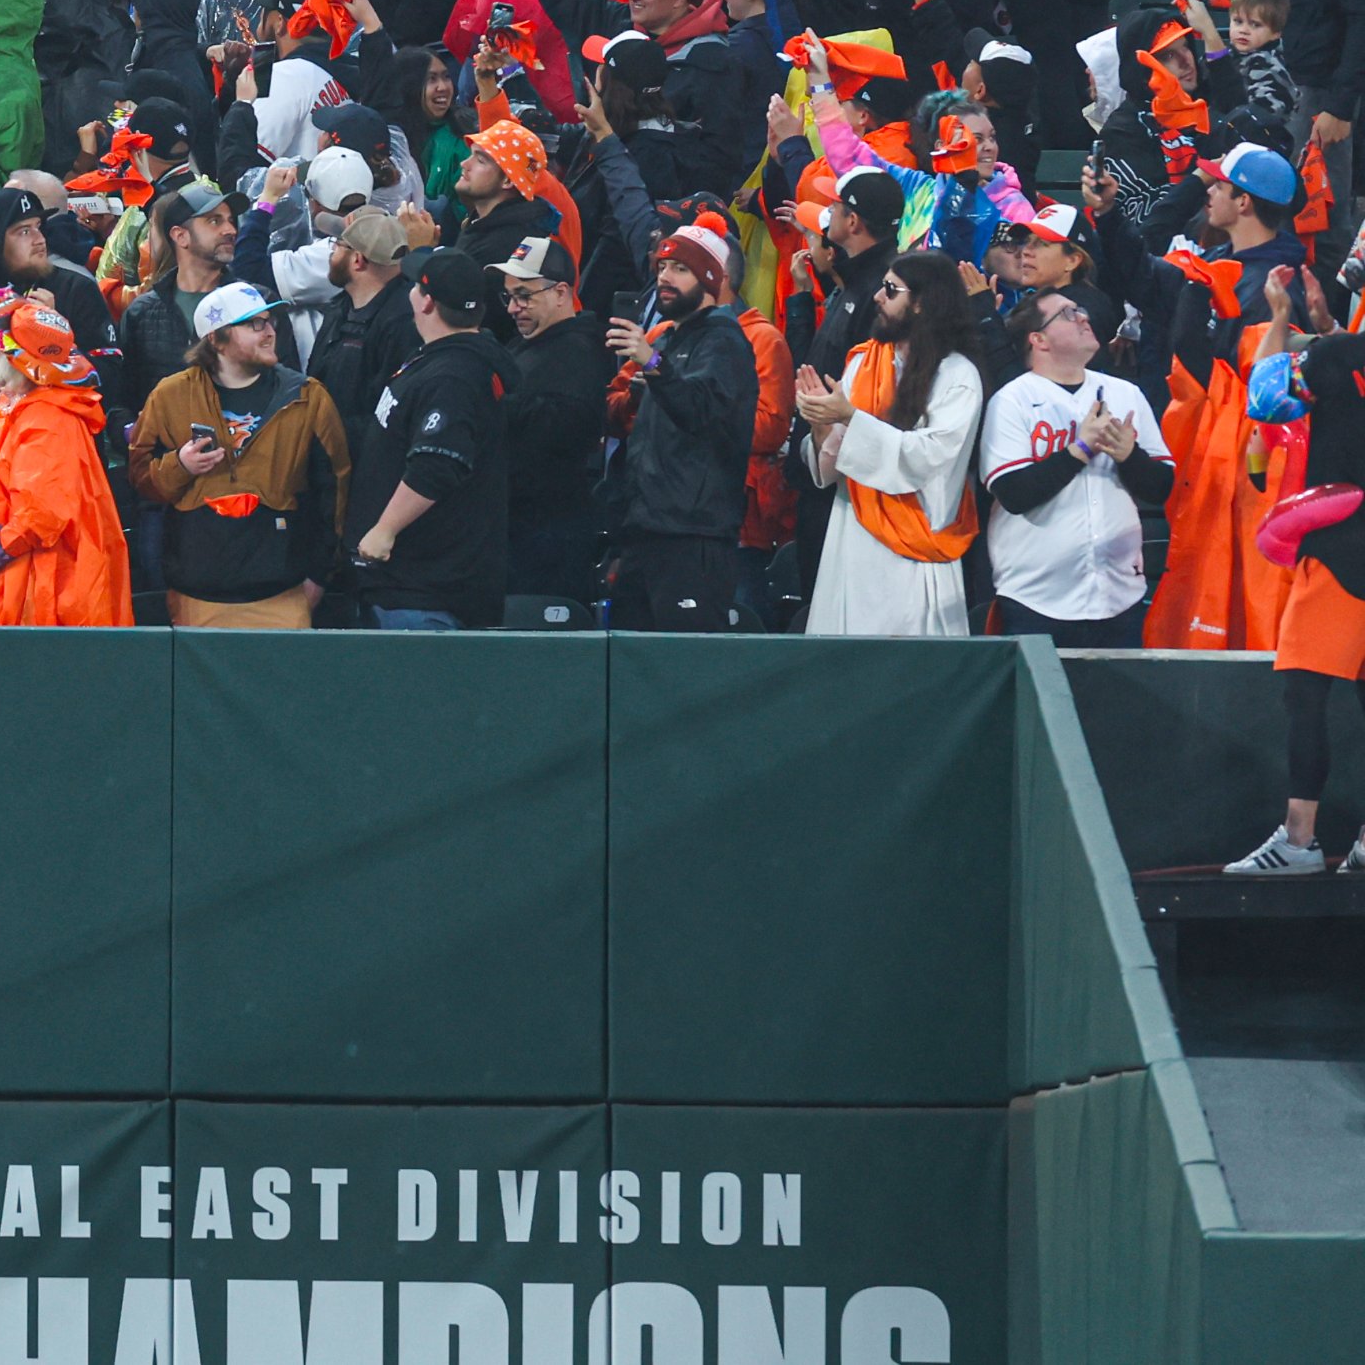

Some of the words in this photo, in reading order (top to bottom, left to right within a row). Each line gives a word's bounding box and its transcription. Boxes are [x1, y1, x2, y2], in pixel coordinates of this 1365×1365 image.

[0, 1164, 92, 1239] AL
[140, 1165, 349, 1242] EAST
[398, 1168, 802, 1247] DIVISION
